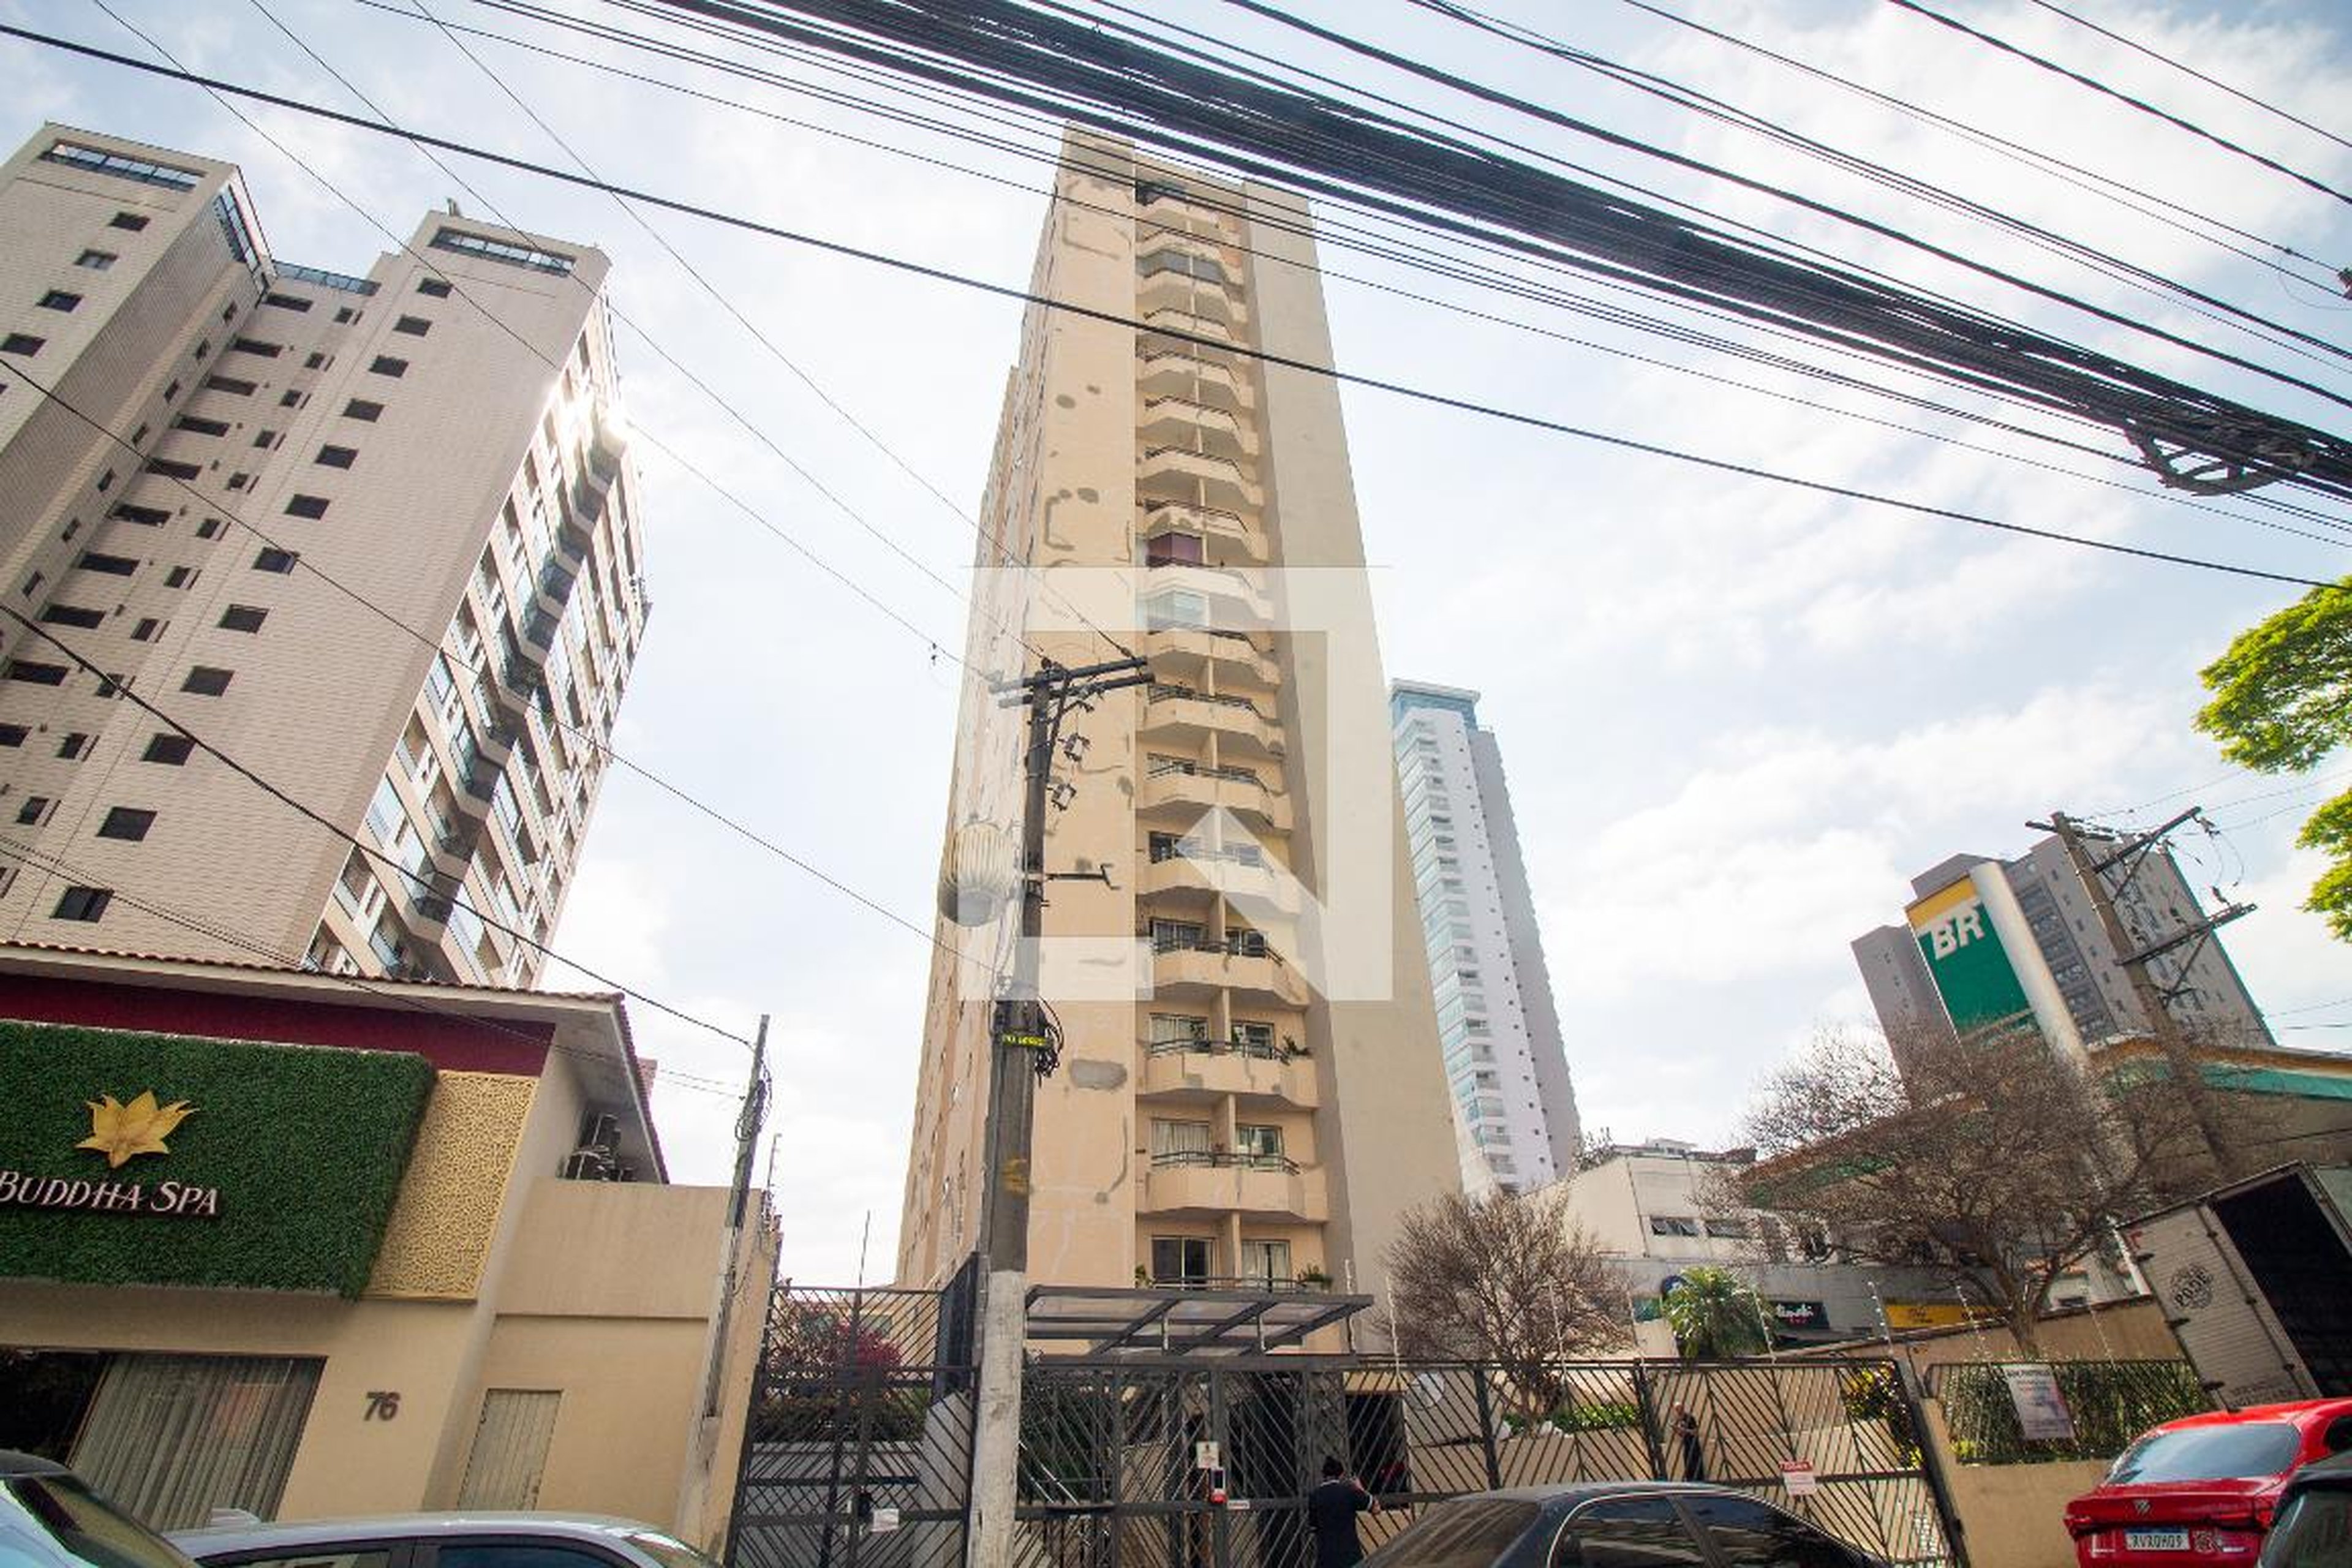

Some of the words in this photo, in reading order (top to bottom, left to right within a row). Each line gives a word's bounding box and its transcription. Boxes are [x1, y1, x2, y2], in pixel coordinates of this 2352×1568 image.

[1930, 905, 1985, 960] BR
[0, 1170, 143, 1210] BUDDHA
[151, 1181, 217, 1215] SPA
[364, 1391, 401, 1421] 76
